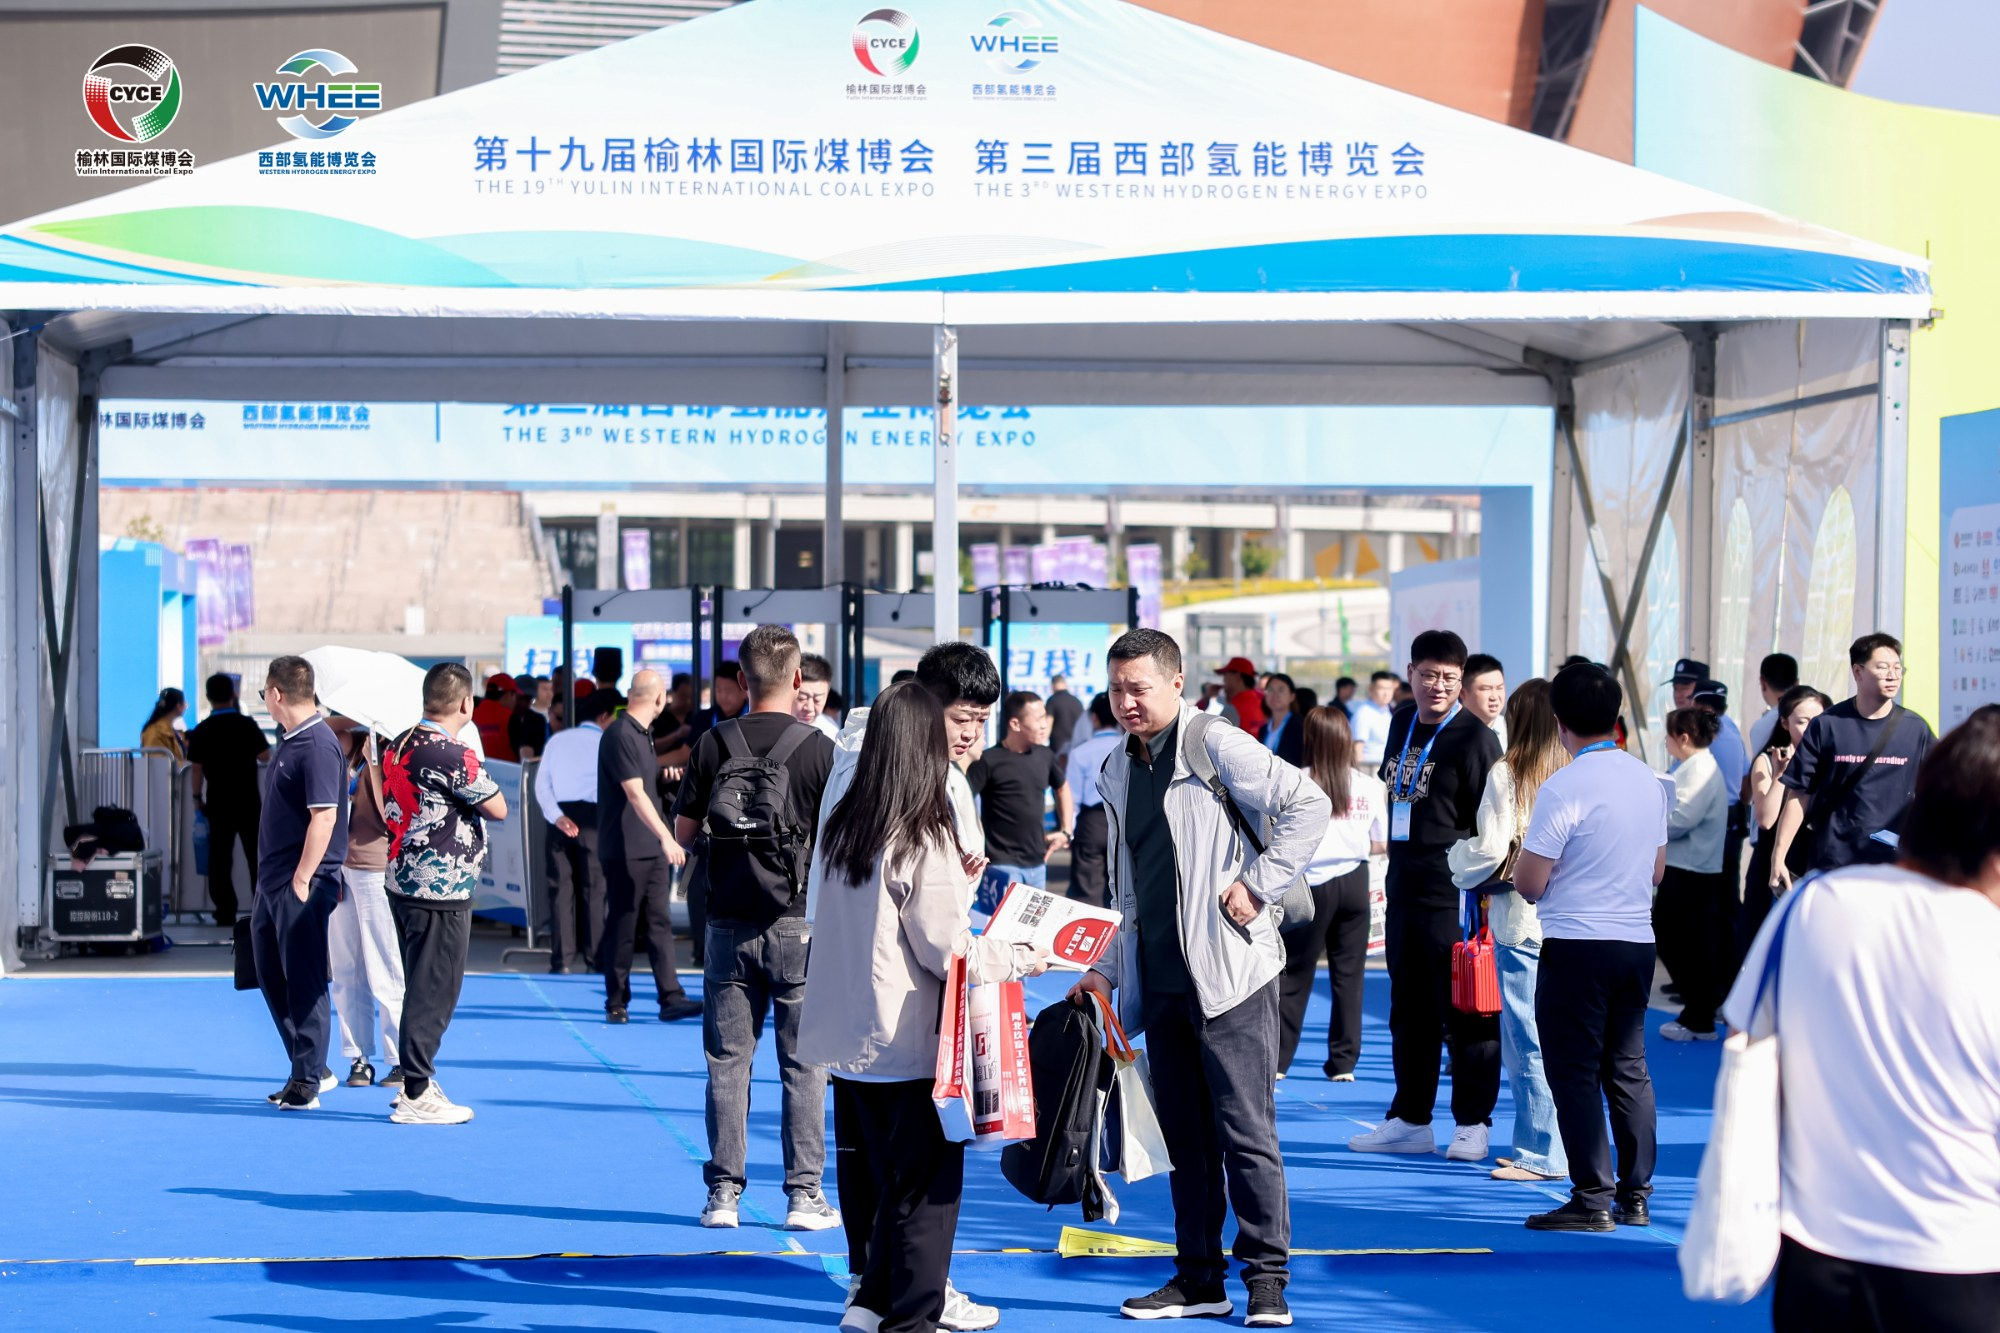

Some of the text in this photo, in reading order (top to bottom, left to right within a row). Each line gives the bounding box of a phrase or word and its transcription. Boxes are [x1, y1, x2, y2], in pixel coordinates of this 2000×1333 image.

[870, 38, 906, 49] CYCE
[970, 36, 1059, 53] WHEE
[846, 84, 927, 96] 榆林国际煤博会
[972, 84, 1057, 96] 西部氢能博览会
[473, 135, 935, 175] 第十九届榆林国际煤博会
[974, 139, 1426, 178] 第三届西部氢能博览会
[474, 179, 515, 194] THE
[570, 180, 633, 195] YULIN
[640, 181, 812, 197] INTERNATIONAL
[820, 182, 874, 197] COAL
[881, 182, 935, 197] EXPO
[974, 182, 1014, 197] THE
[1056, 183, 1155, 198] WESTERN
[1163, 184, 1278, 199] HYDROGEN
[1286, 185, 1368, 199] ENERGY
[1375, 185, 1428, 199] EXPO
[503, 426, 547, 442] THE
[603, 426, 717, 444] WESTERN
[730, 429, 858, 445] HYDROGN
[976, 430, 1036, 447] EXPO
